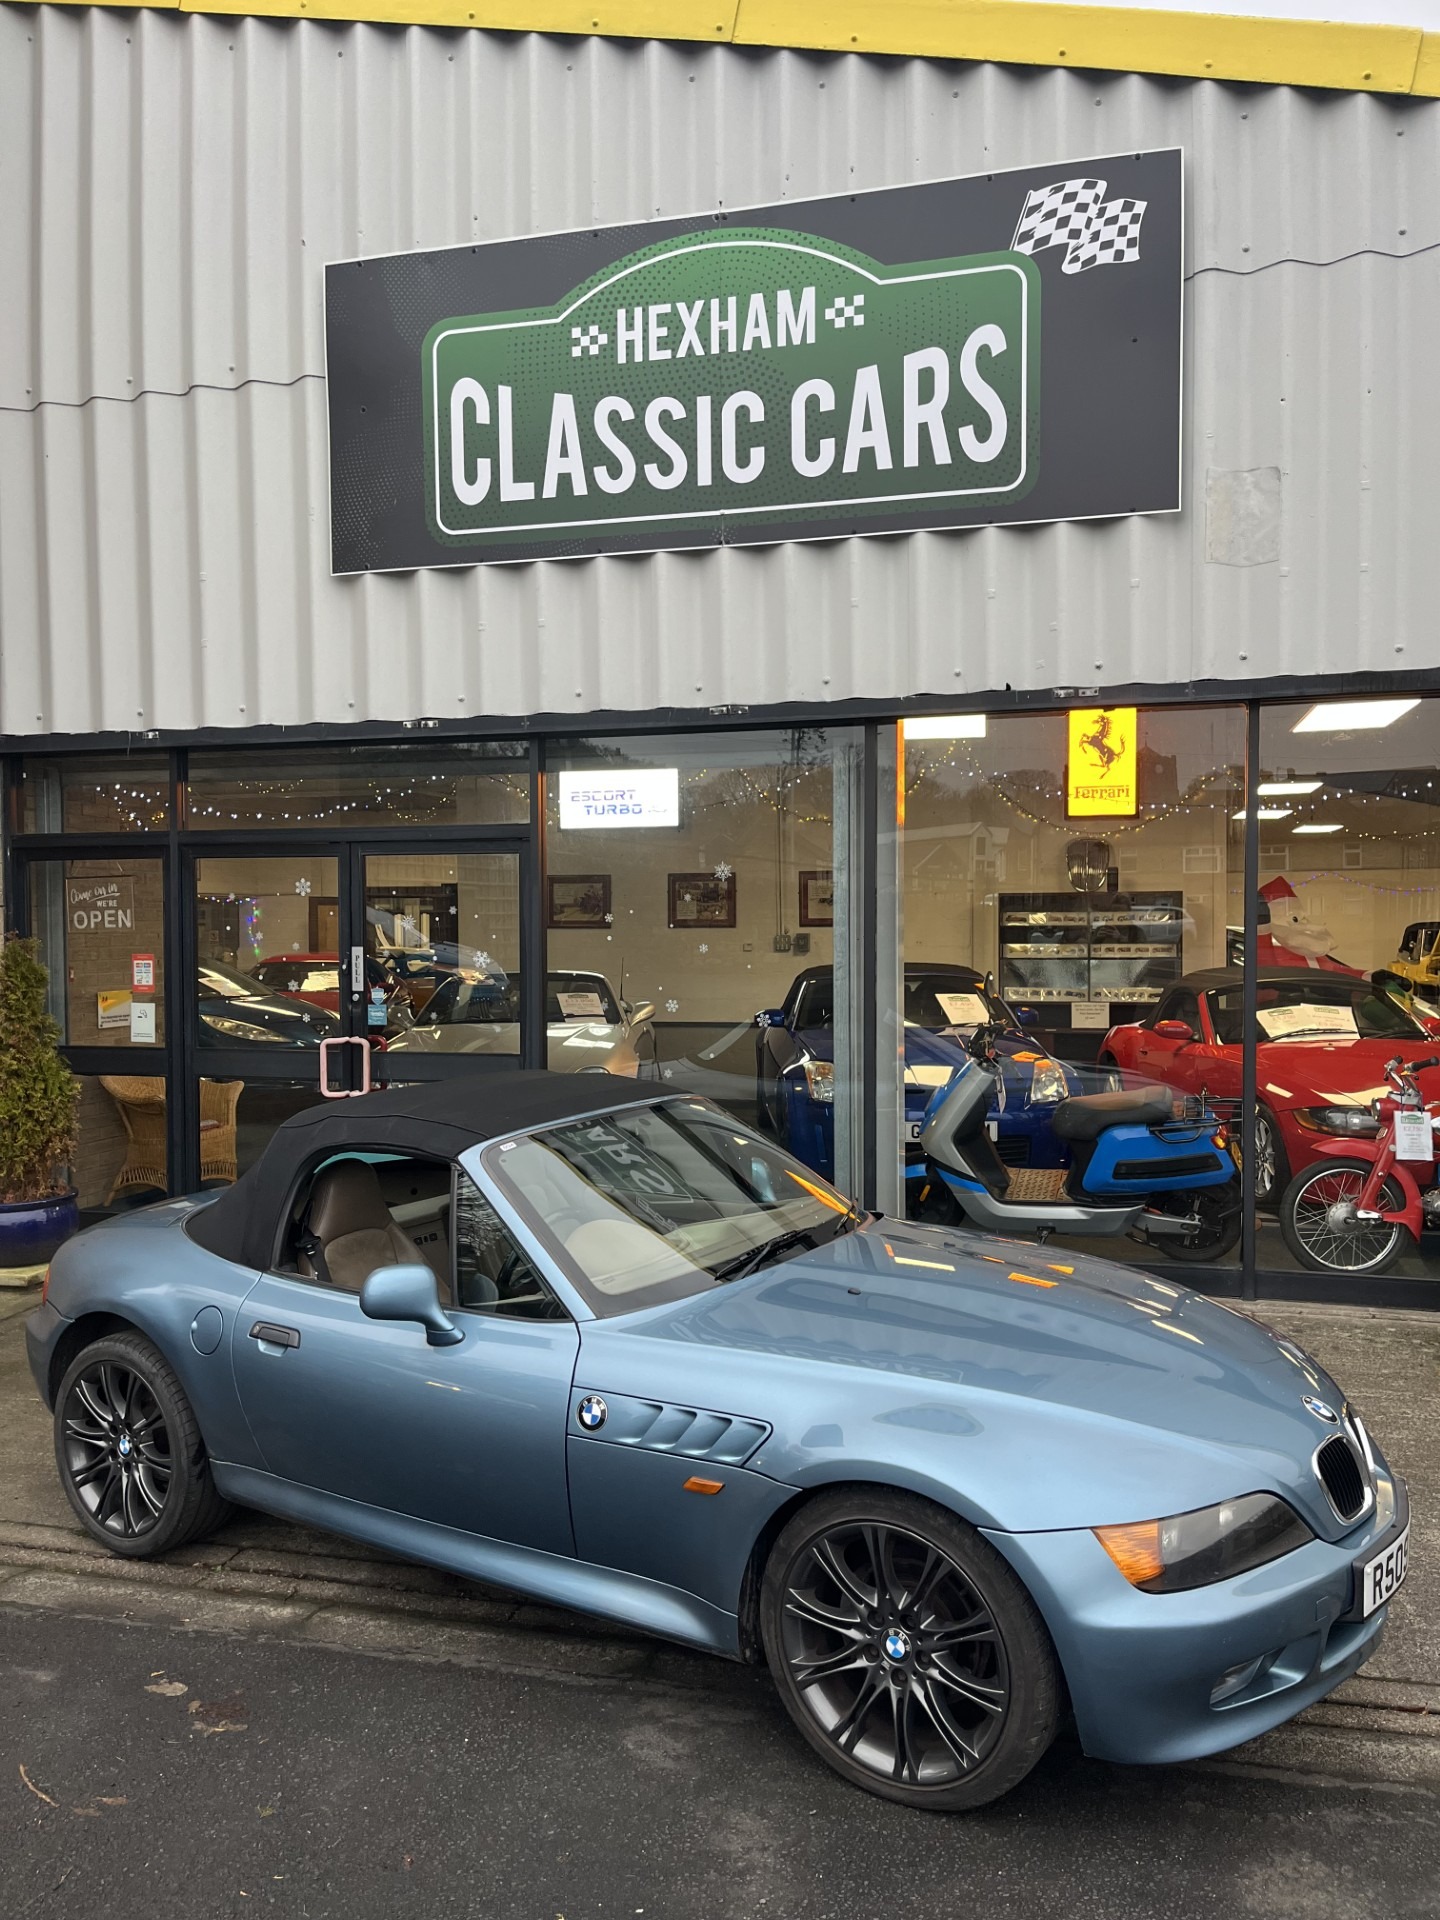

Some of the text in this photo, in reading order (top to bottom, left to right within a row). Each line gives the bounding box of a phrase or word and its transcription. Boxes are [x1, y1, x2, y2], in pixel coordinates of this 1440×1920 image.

[616, 286, 816, 365] HEXHAM
[450, 323, 1008, 506] CLASSIC CARS
[571, 789, 636, 802] ESCORT
[1074, 785, 1130, 799] Ferrari
[584, 804, 643, 815] TURBO
[96, 899, 118, 908] WE'RE
[73, 908, 132, 930] OPEN
